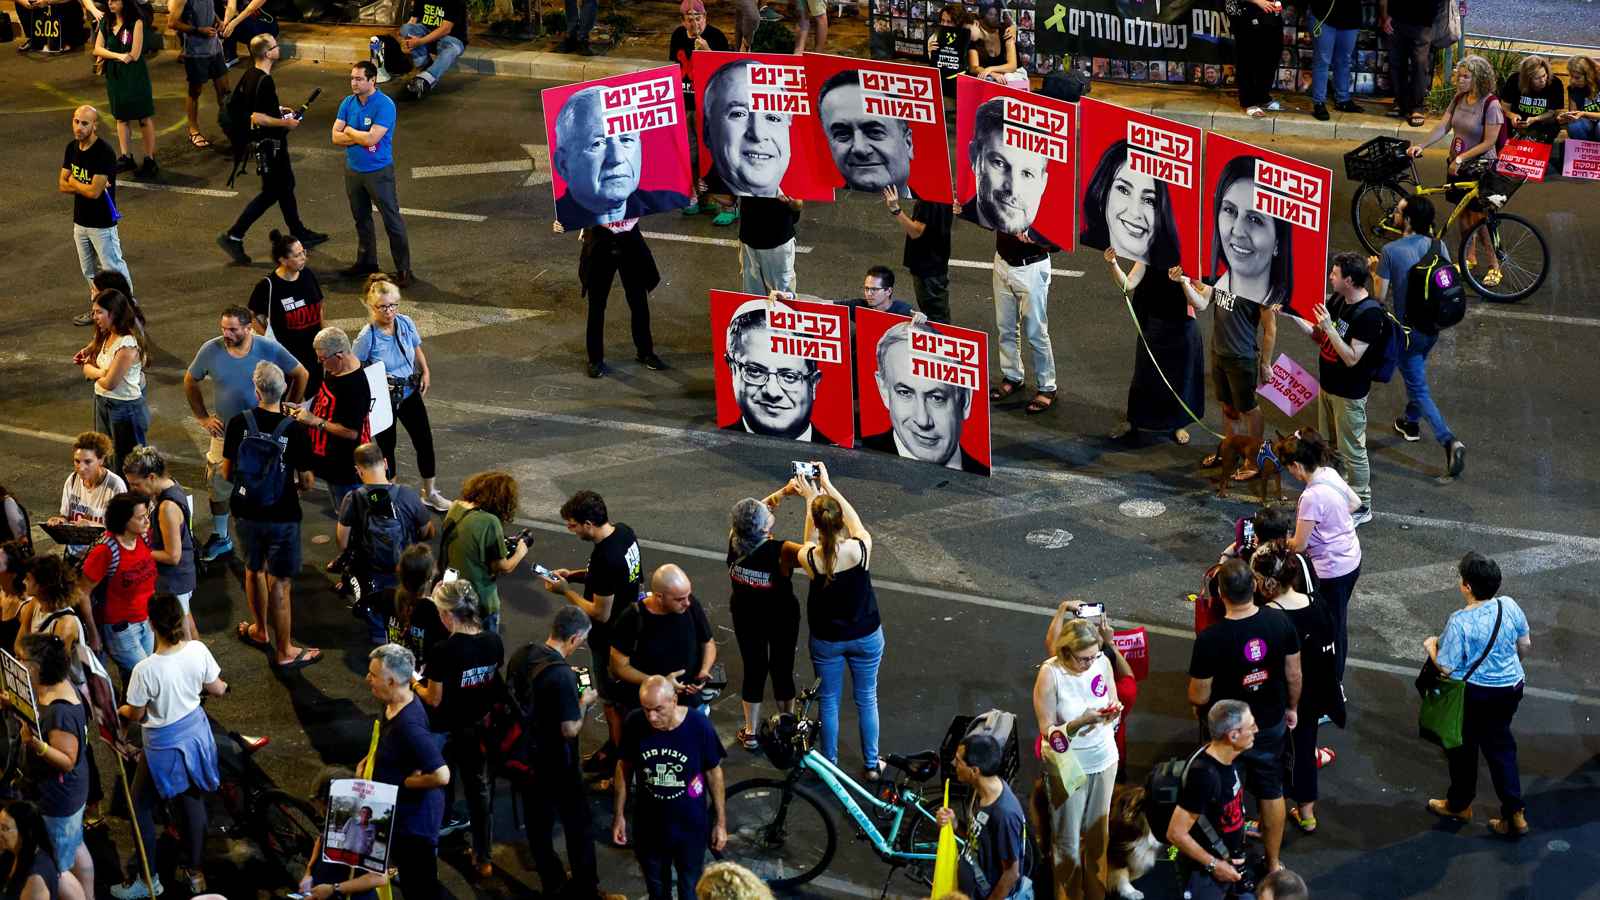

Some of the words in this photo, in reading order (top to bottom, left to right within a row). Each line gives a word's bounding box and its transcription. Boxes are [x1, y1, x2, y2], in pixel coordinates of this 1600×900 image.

[34, 19, 59, 37] S.O.S
[1068, 7, 1121, 42] חוזרים
[1124, 16, 1187, 50] כשכולם
[604, 80, 670, 110] קבינט
[863, 73, 929, 98] קבינט
[607, 106, 673, 135] המוות
[866, 97, 931, 121] המוות
[1007, 101, 1064, 134] קבינט
[1006, 127, 1064, 160] המוות
[1130, 125, 1190, 158] קבינט
[1129, 151, 1189, 186] המוות
[1258, 163, 1319, 200] קבינט
[1256, 191, 1317, 228] המוות
[770, 310, 836, 337] קבינט
[770, 336, 838, 361] המוות
[912, 332, 975, 362] קבינט
[912, 358, 976, 387] המוות
[1288, 375, 1312, 400] DEAL
